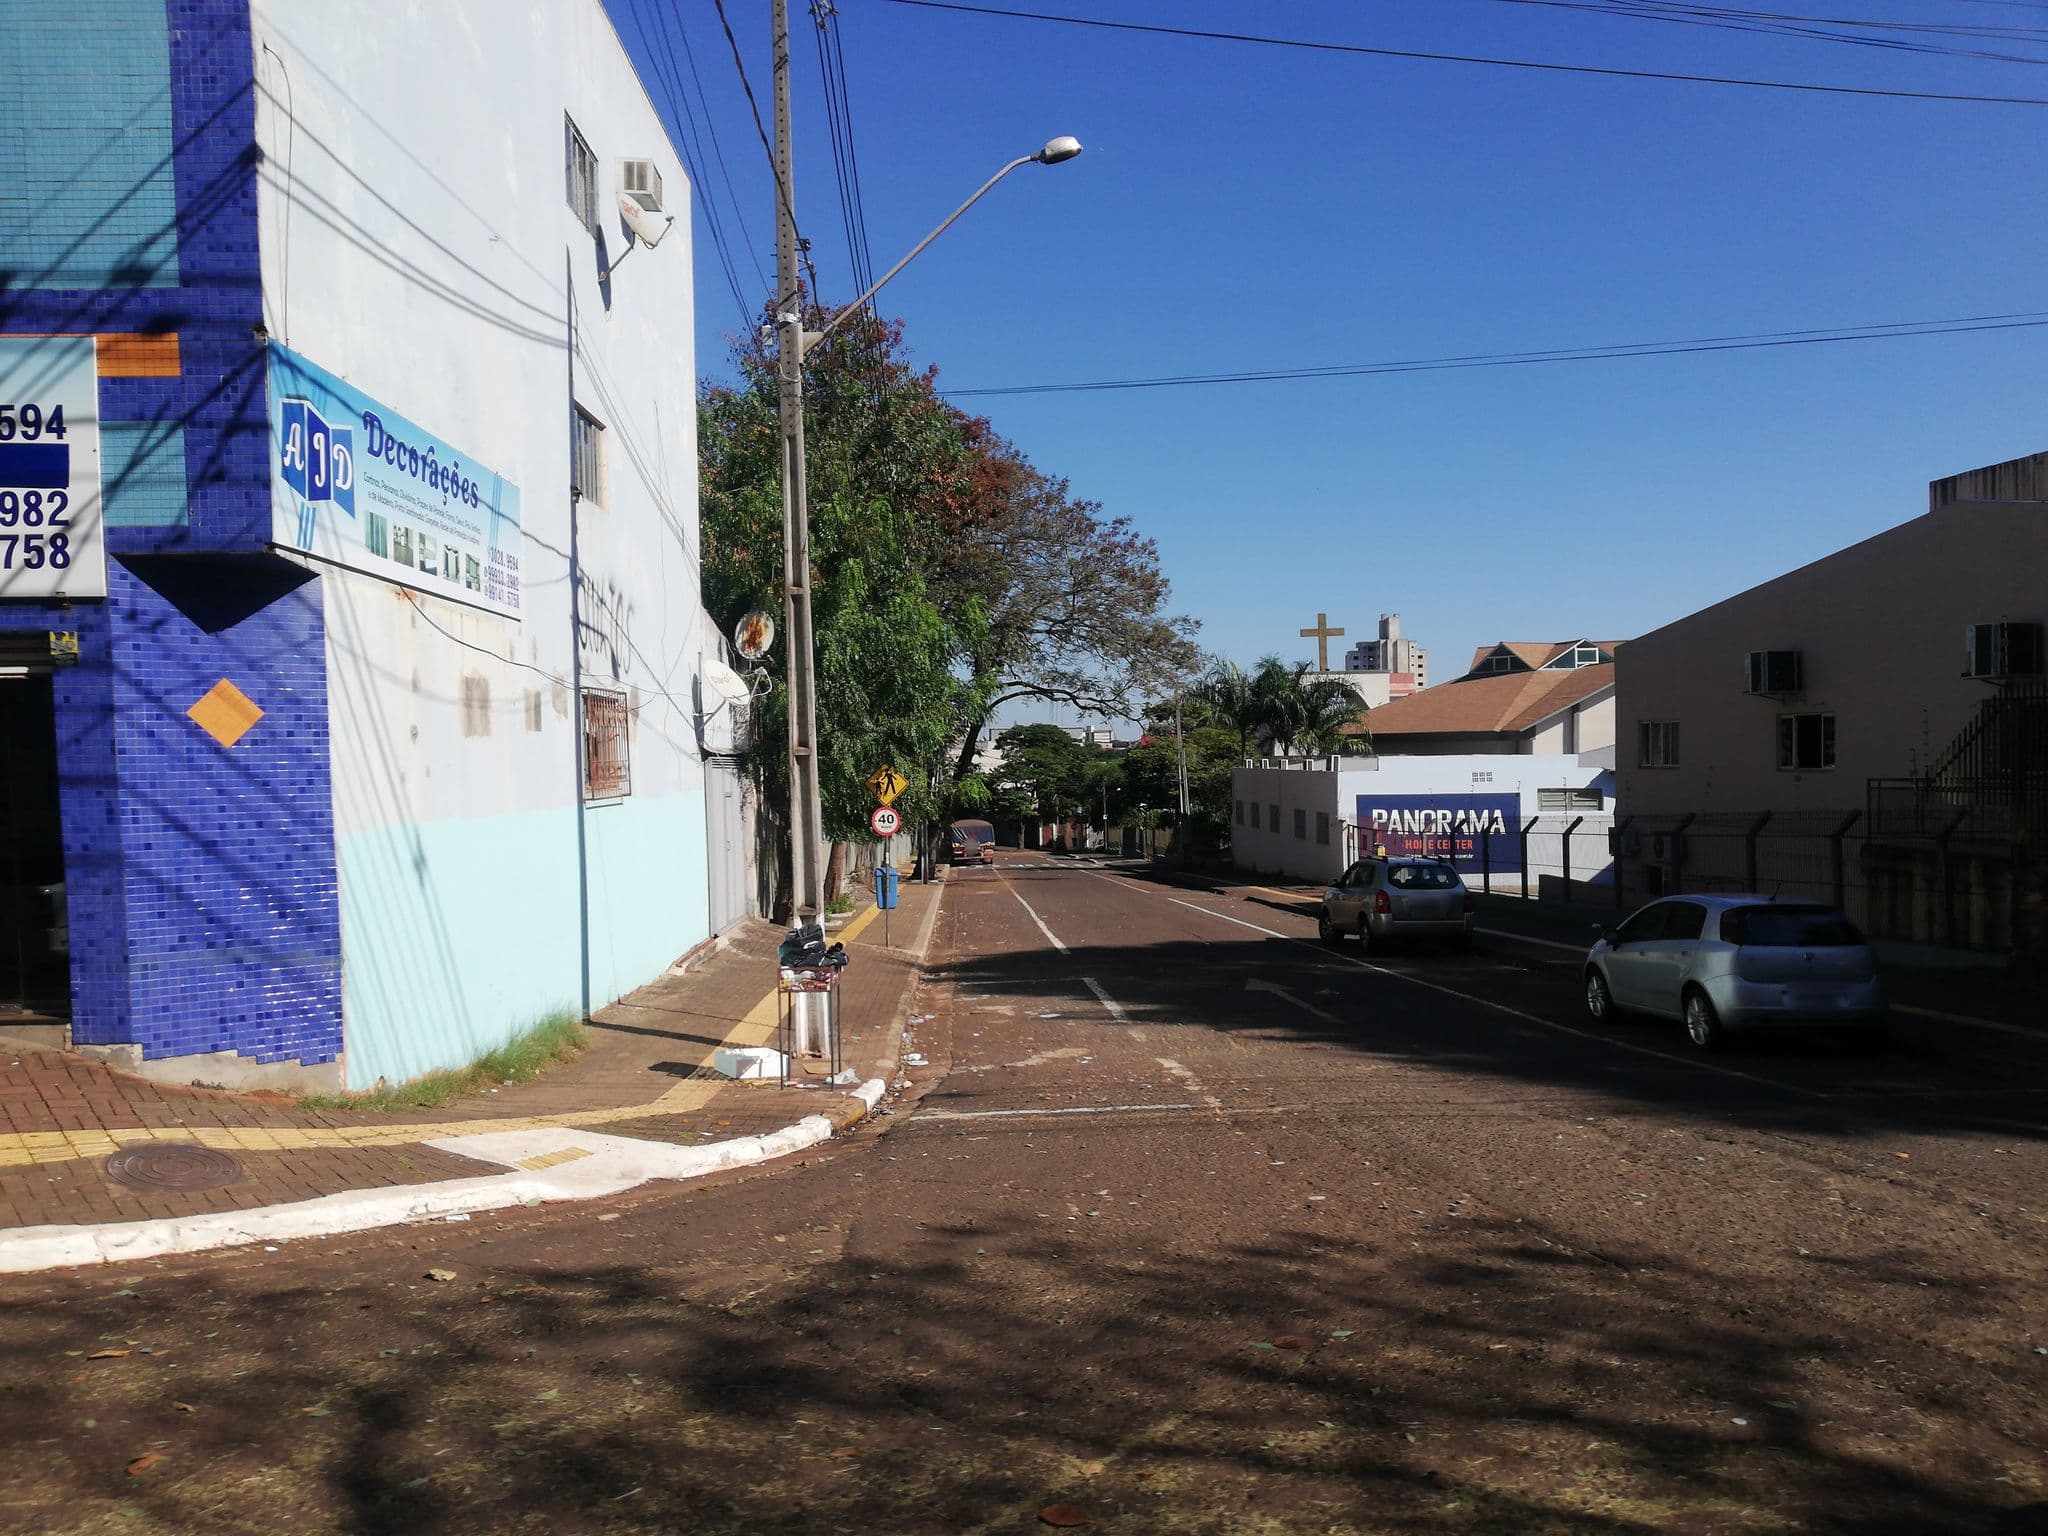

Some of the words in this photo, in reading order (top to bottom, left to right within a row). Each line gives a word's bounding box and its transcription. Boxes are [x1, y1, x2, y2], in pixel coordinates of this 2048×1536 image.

[0, 404, 67, 440] 594
[362, 410, 479, 508] Decorações
[0, 490, 69, 527] 982
[0, 532, 70, 569] 758
[878, 814, 894, 824] 40
[1372, 809, 1506, 835] PANORAMA
[1437, 839, 1473, 850] CETER
